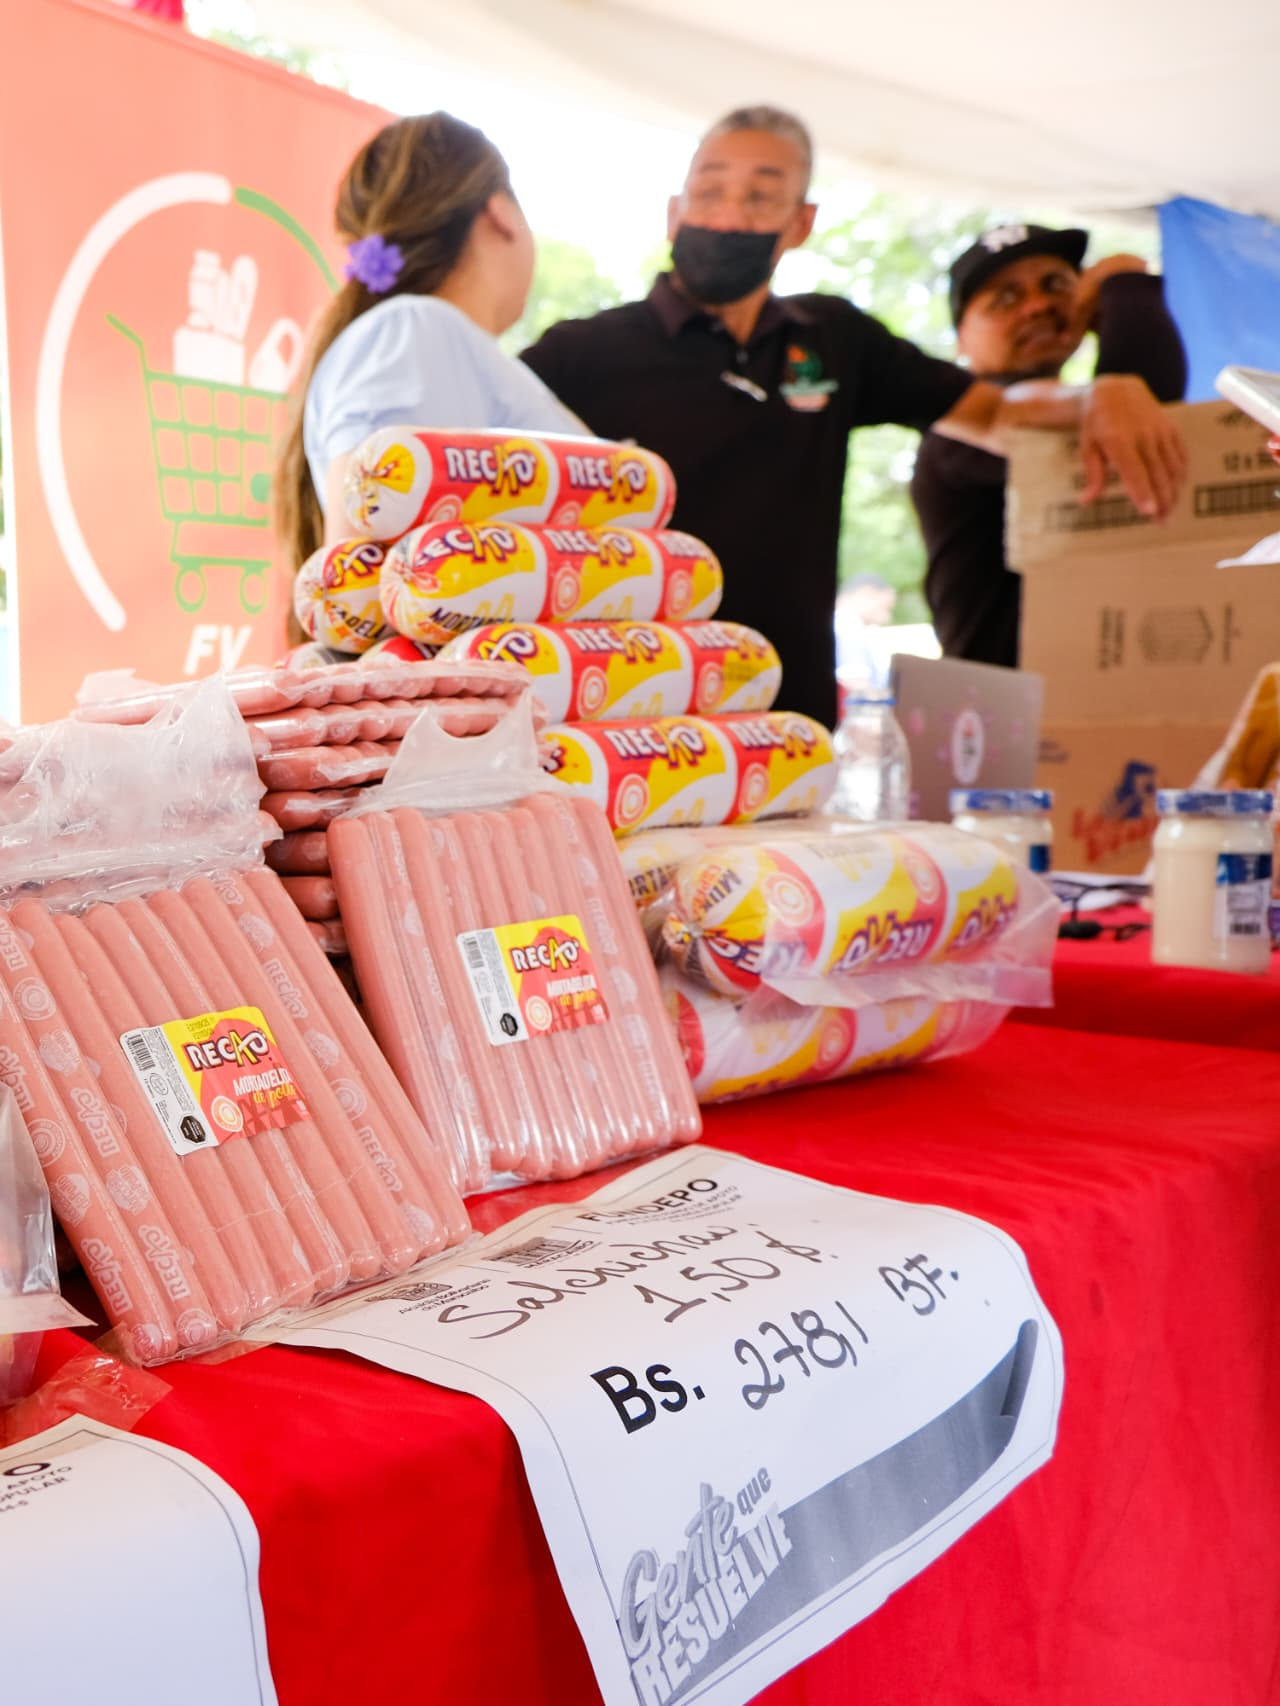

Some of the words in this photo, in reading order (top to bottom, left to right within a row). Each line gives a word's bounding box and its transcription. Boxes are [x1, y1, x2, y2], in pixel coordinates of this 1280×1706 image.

[443, 443, 537, 496] RECAO
[566, 451, 648, 503] RECAO
[602, 719, 708, 770] RECAO
[508, 936, 581, 972] RECAO
[182, 1029, 269, 1071] RECAO
[577, 1178, 718, 1222] FUNDEPO
[633, 1256, 782, 1325] 1,50
[590, 1363, 706, 1434] Bs.
[620, 1482, 738, 1660] Gente
[736, 1466, 772, 1517] que
[630, 1503, 794, 1706] RESUELVE
